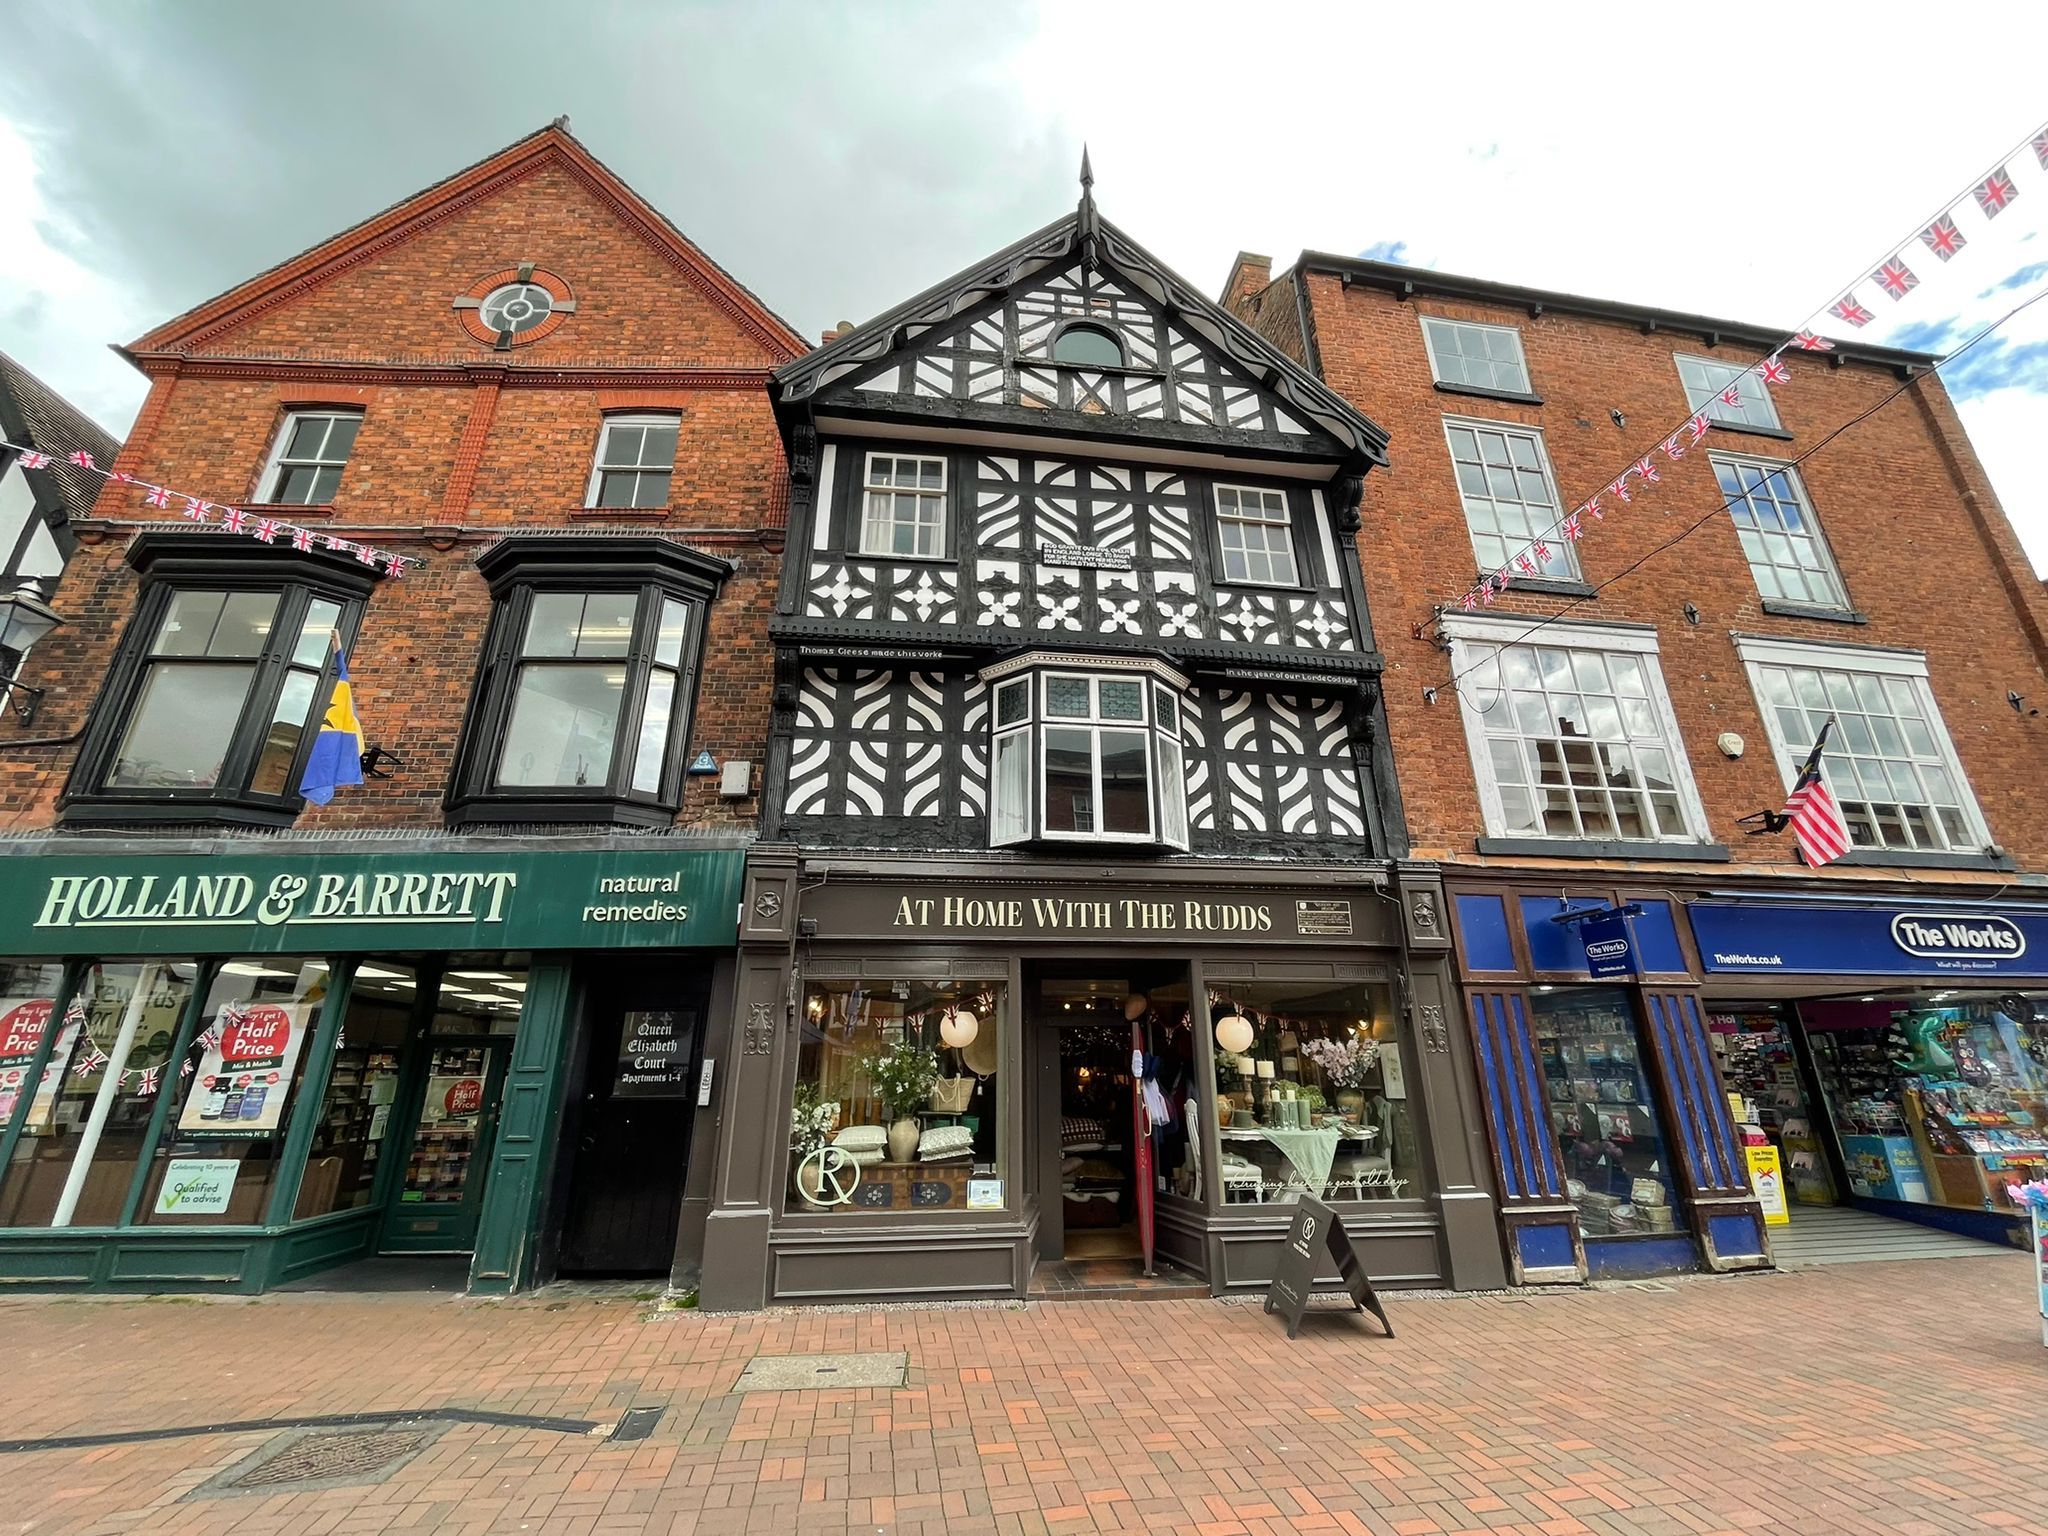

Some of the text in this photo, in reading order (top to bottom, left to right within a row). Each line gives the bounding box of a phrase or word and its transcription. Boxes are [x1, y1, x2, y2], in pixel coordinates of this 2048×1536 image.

[800, 645, 834, 655] Thomas
[600, 871, 681, 893] natural
[33, 872, 517, 926] HOLLAND & BARRETT
[582, 899, 688, 921] remedies
[893, 895, 935, 926] AT
[942, 897, 1023, 927] HOME
[1031, 898, 1112, 929] WITH
[1119, 899, 1176, 929] THE
[1184, 901, 1272, 931] RUDDS
[1900, 921, 2017, 949] The Works
[1589, 943, 1625, 955] The Works
[1713, 953, 1783, 965] TheWorks.co.uk
[237, 1022, 279, 1038] Half
[637, 1023, 673, 1036] Queen
[3, 1034, 40, 1051] Pric
[232, 1039, 274, 1055] Price
[627, 1039, 678, 1055] Elizabeth
[634, 1056, 666, 1070] Court
[622, 1073, 667, 1084] Apartments
[453, 1089, 477, 1100] Half
[451, 1100, 476, 1110] Price
[174, 1182, 220, 1197] Qualified
[1331, 1170, 1360, 1197] good
[1361, 1169, 1382, 1186] old
[1383, 1169, 1410, 1195] days
[181, 1193, 222, 1203] to advise
